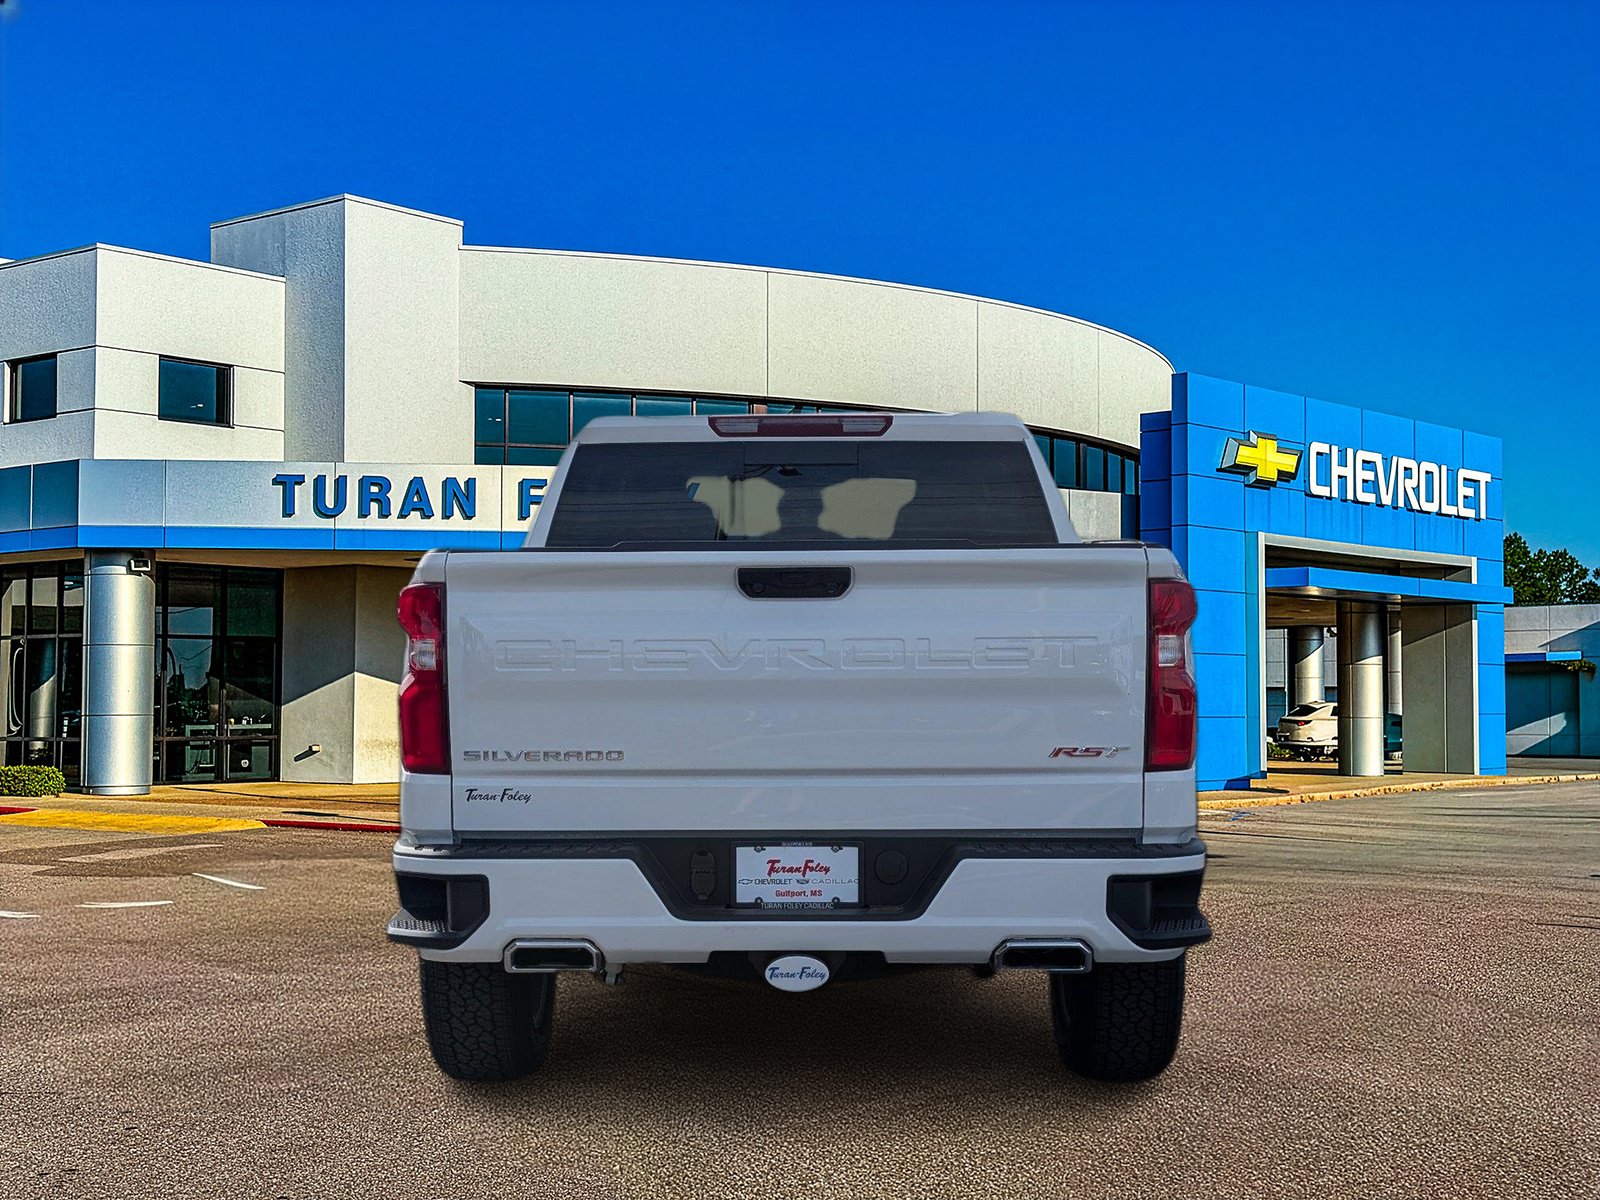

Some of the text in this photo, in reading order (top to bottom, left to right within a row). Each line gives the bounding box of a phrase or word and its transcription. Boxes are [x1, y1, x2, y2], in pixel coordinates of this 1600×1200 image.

[1308, 441, 1492, 521] CHEVROLET
[272, 474, 548, 521] TURAN F
[494, 636, 1100, 672] CHEVROLET
[463, 750, 624, 762] SILVERADO
[1048, 747, 1132, 759] RST
[775, 889, 823, 898] Gulfport, MS
